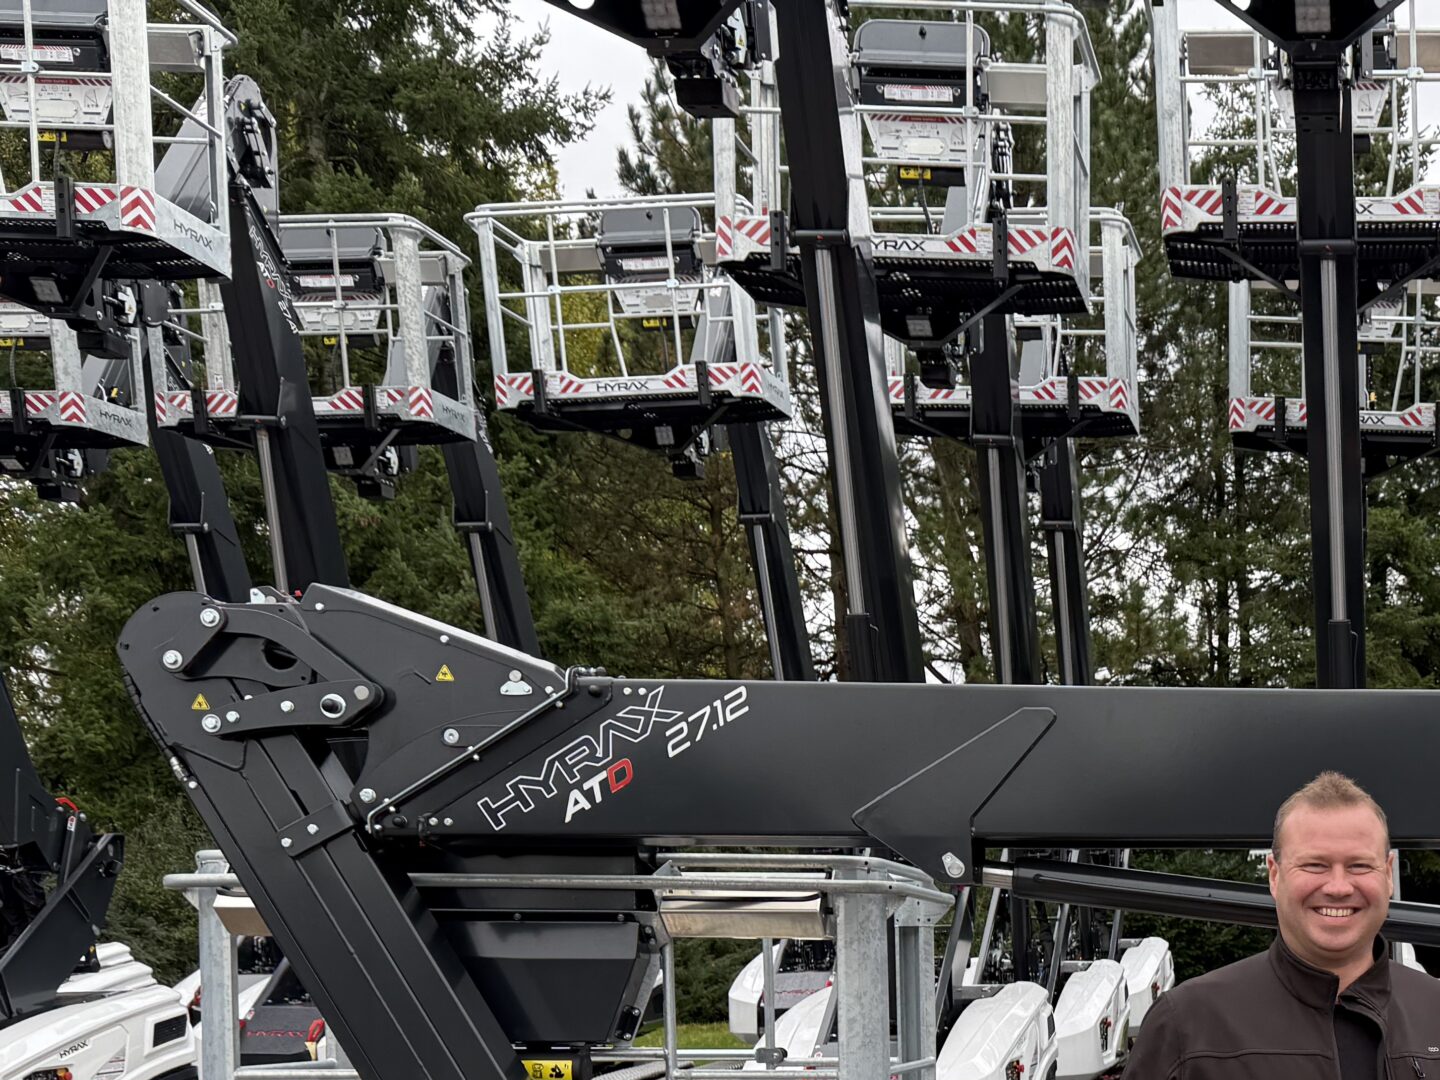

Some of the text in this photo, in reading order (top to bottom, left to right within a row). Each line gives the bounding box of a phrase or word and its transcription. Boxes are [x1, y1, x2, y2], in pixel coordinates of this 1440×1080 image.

[173, 218, 213, 252] HYRAX
[870, 239, 926, 252] YRAX
[596, 380, 650, 393] HYRAX
[99, 409, 134, 428] HYRAX
[476, 684, 750, 832] HYRAX 27.12
[564, 757, 634, 824] ATD
[58, 1039, 90, 1059] HYRAX
